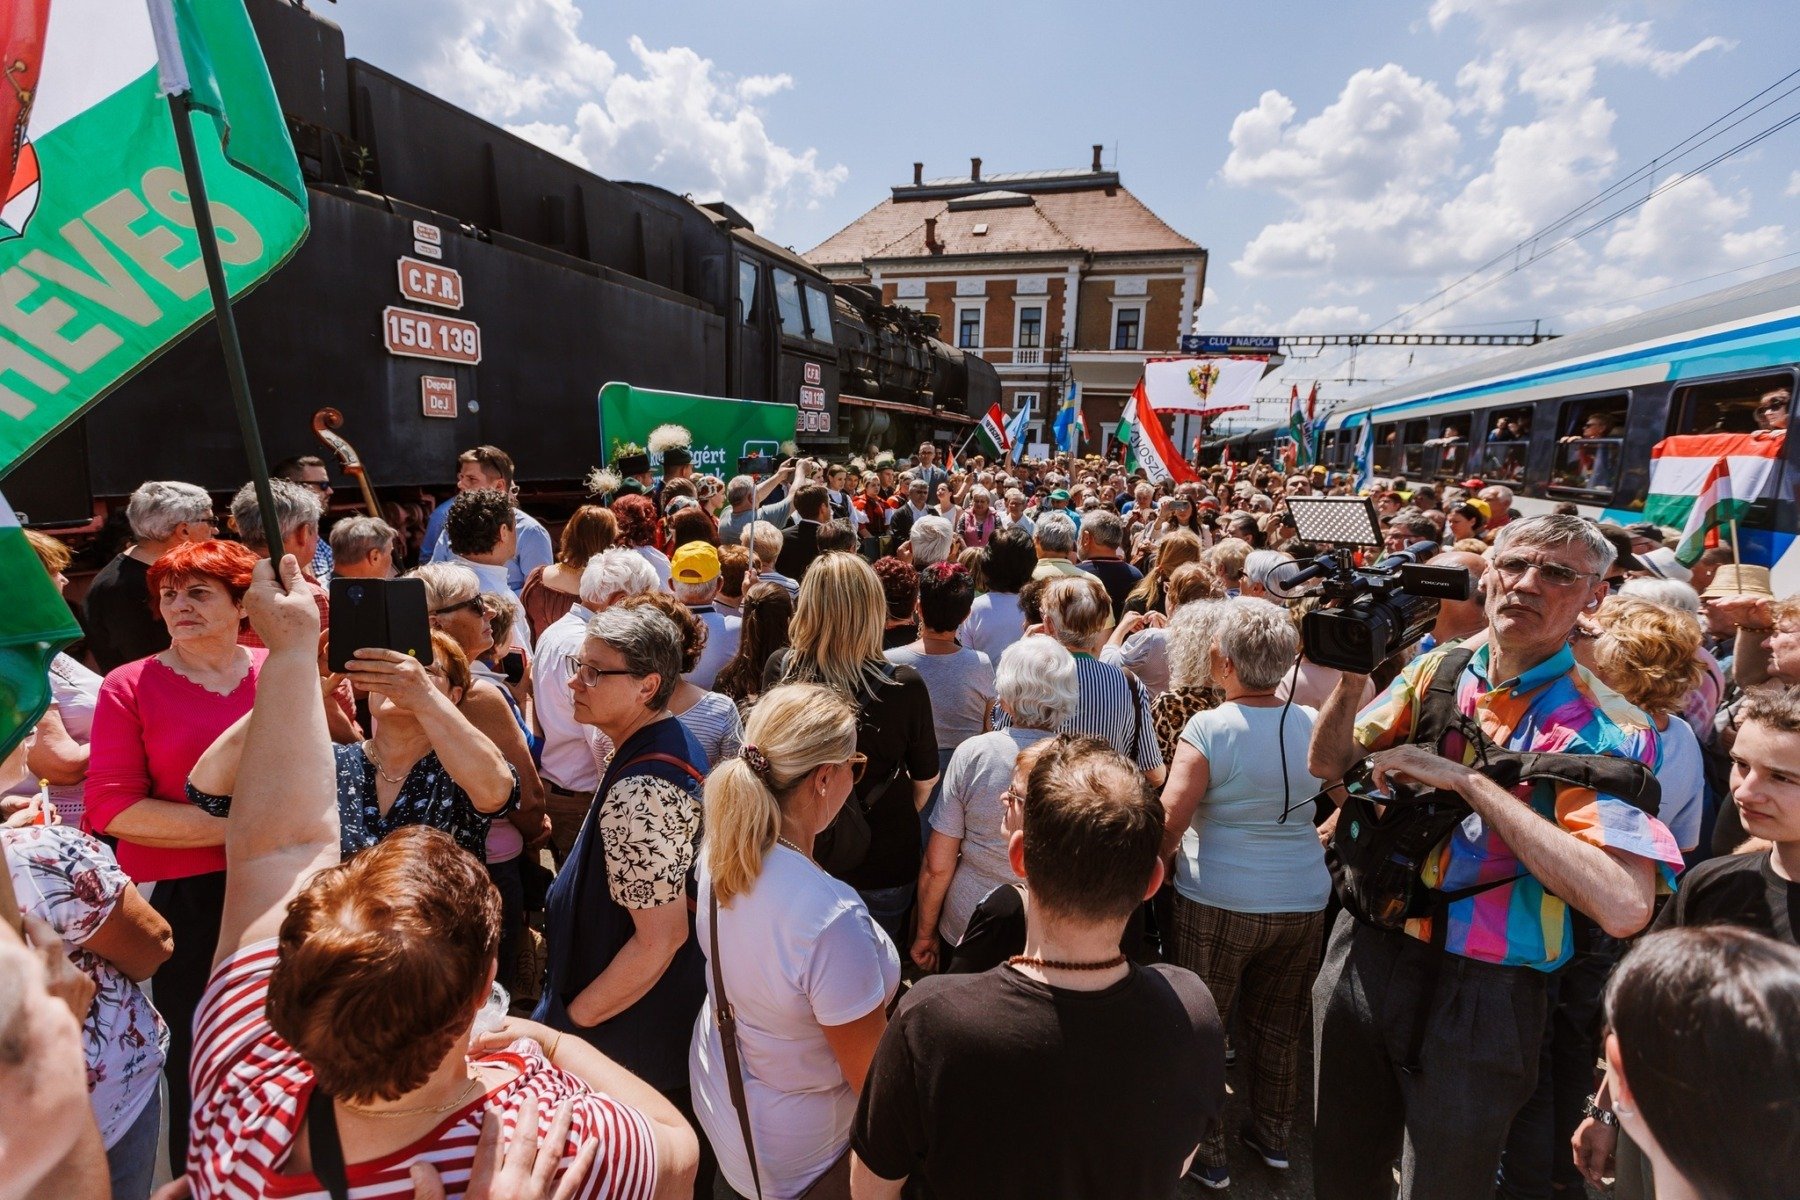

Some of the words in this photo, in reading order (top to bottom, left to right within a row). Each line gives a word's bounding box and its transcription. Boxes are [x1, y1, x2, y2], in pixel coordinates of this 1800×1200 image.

[409, 268, 458, 300] C.F.R.
[1209, 337, 1233, 346] CLUJ
[1235, 337, 1274, 346] NAPOCA
